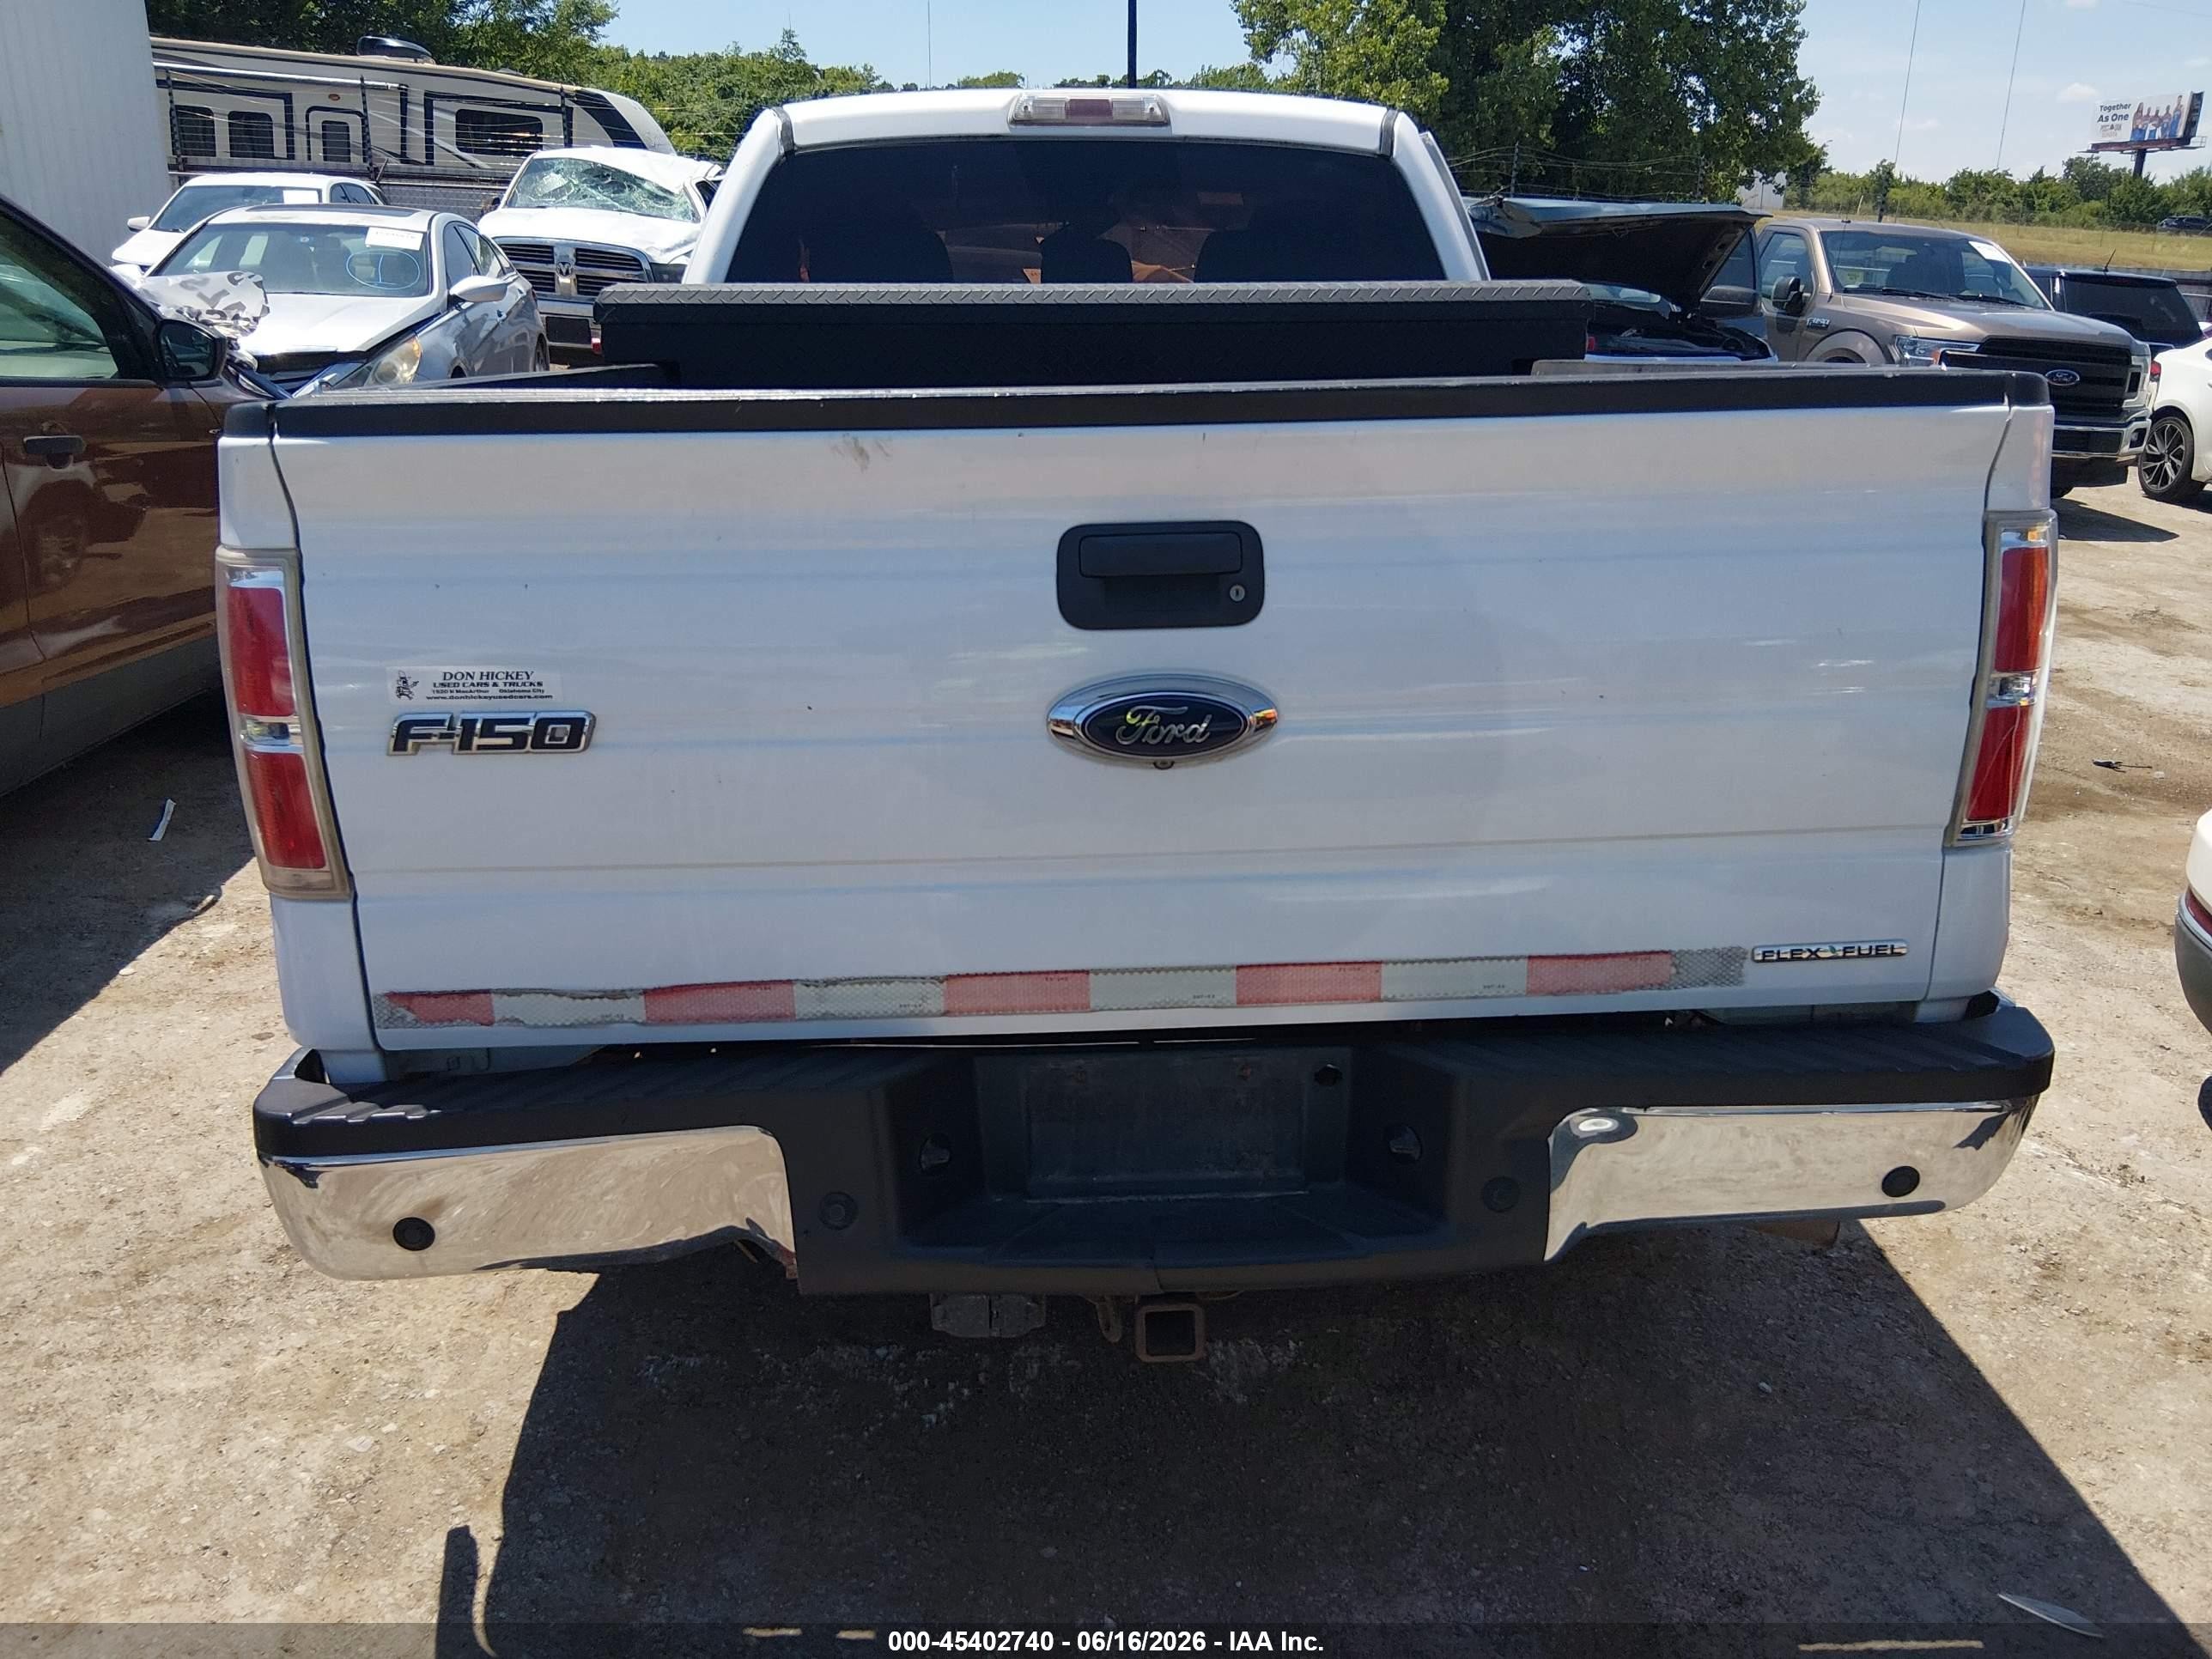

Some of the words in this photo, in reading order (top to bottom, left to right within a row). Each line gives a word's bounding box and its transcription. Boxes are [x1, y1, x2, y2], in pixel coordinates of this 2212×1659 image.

[2100, 103, 2131, 112] Together
[2097, 114, 2109, 123] As
[2111, 112, 2129, 122] One
[442, 672, 475, 681] DON
[479, 671, 534, 681] HICKEY
[1116, 705, 1212, 745] Ford
[388, 710, 597, 756] F-150
[1761, 947, 1821, 961] FLEX
[1842, 944, 1902, 957] FUEL
